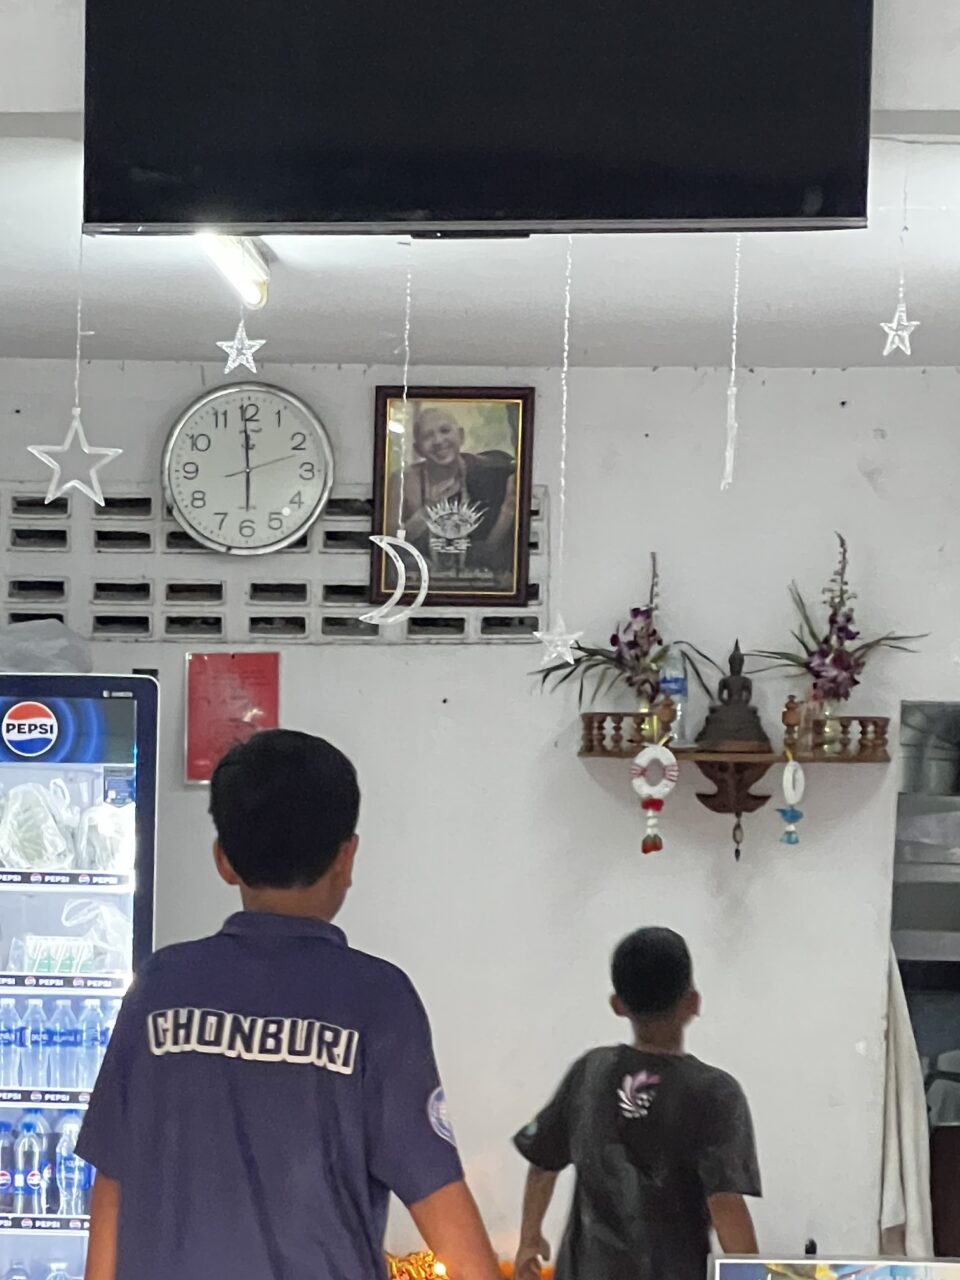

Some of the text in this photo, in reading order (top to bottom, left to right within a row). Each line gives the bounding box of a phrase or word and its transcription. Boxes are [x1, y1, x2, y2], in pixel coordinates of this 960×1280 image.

[212, 409, 228, 428] 11
[238, 403, 260, 422] 12
[275, 409, 282, 428] 1
[189, 433, 211, 452] 10
[290, 432, 307, 451] 2
[182, 461, 199, 480] 9
[298, 462, 315, 480] 3
[191, 490, 207, 509] 8
[288, 490, 305, 509] 4
[213, 512, 229, 530] 7
[238, 519, 256, 538] 6
[268, 512, 283, 530] 5
[5, 722, 54, 735] PEPSI
[44, 875, 70, 883] PEPSI
[92, 876, 118, 884] PEPSI
[38, 978, 64, 986] PEPSI
[86, 979, 112, 988] PEPSI
[147, 1008, 359, 1075] CHONBURI
[44, 1093, 70, 1101] PEPSI
[35, 1220, 61, 1228] PEPSI
